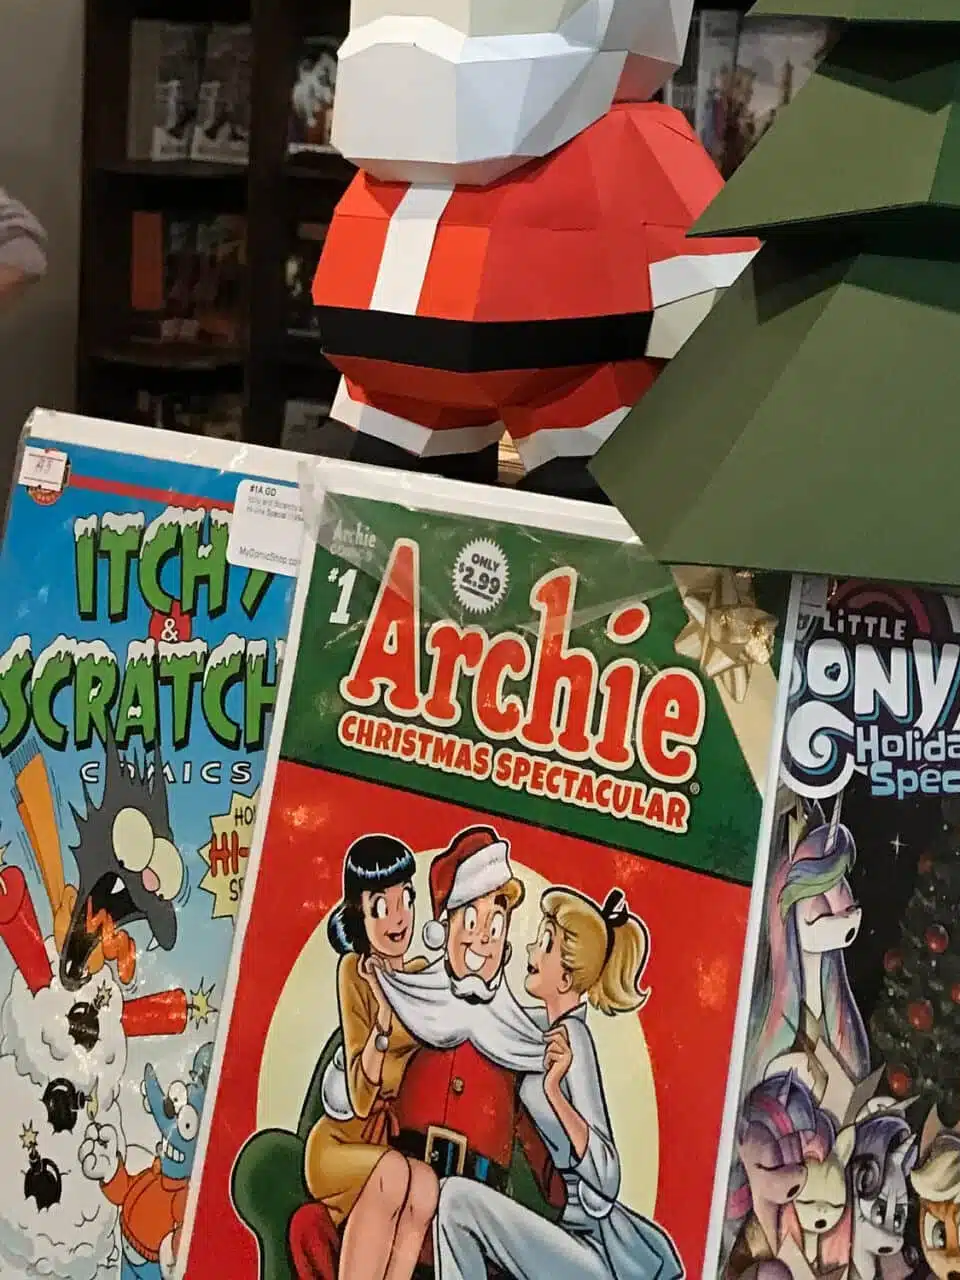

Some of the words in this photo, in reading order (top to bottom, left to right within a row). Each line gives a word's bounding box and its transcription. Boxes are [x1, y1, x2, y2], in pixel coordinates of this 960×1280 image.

[332, 519, 377, 548] Archie
[471, 552, 500, 572] ONLY
[458, 562, 501, 595] $2.99
[327, 567, 358, 625] #1
[160, 617, 179, 643] &
[339, 538, 706, 784] Archie
[80, 760, 252, 784] CICS
[338, 710, 493, 781] CHRISTMAS
[494, 747, 691, 834] SPECTACULAR
